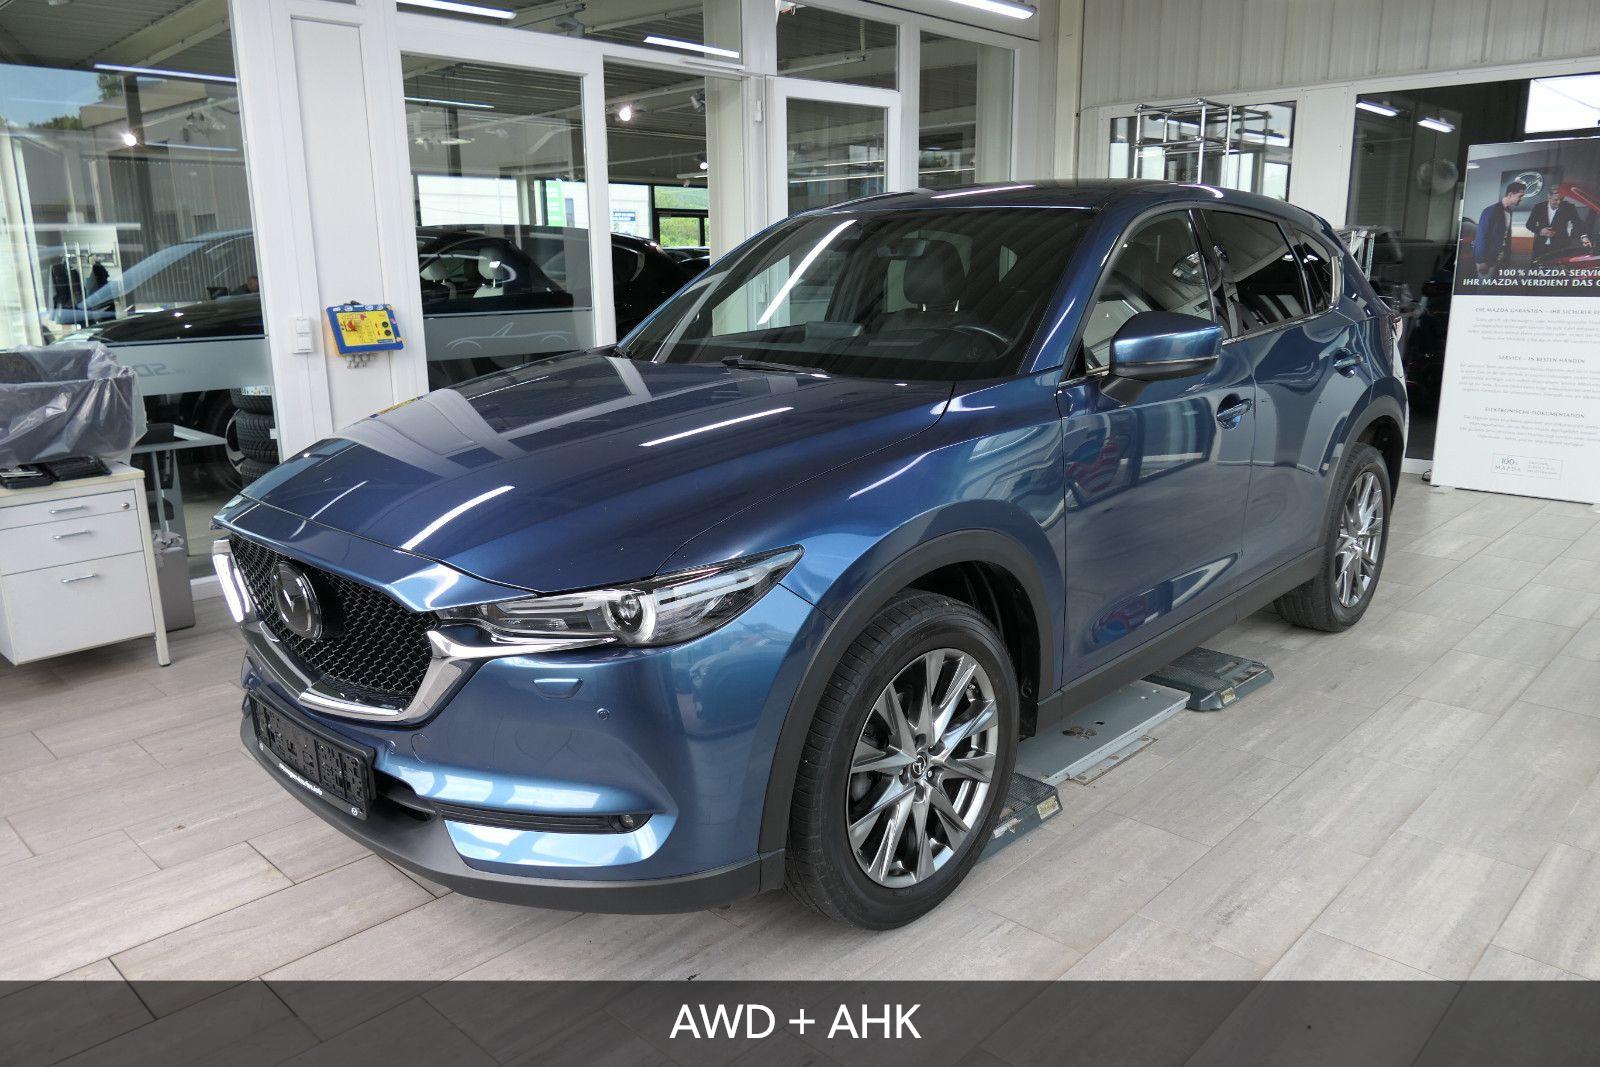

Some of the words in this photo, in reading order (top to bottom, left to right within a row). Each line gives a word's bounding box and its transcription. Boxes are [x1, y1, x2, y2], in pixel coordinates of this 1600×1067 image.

[1528, 269, 1566, 277] MAZDA
[1521, 279, 1569, 287] VERDIENT
[1572, 279, 1593, 287] DAS
